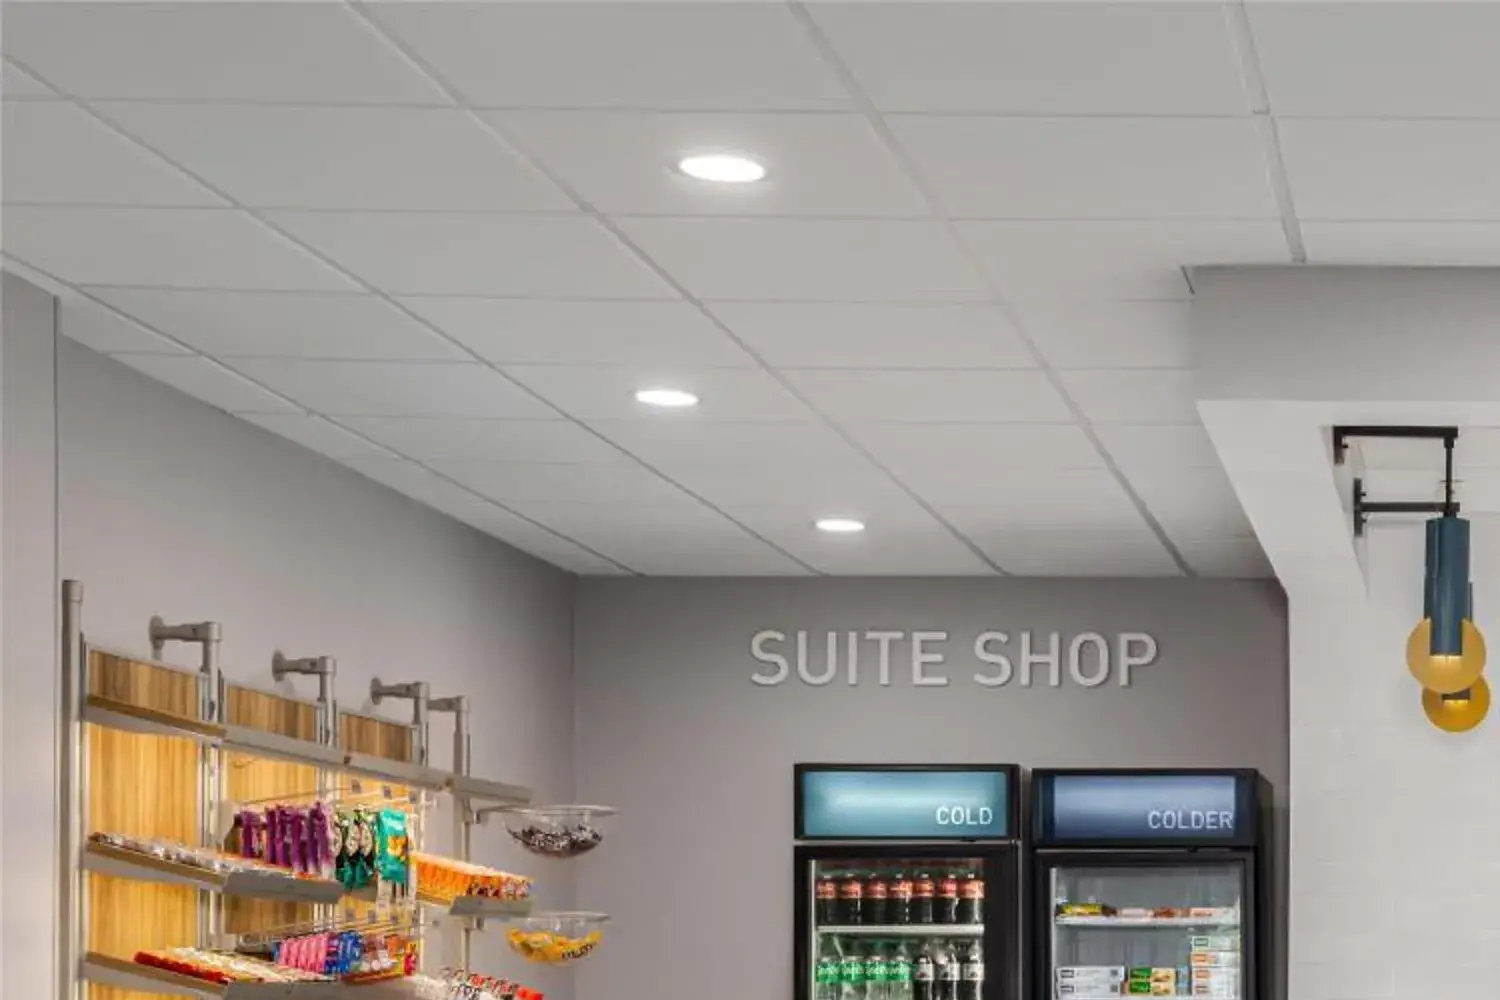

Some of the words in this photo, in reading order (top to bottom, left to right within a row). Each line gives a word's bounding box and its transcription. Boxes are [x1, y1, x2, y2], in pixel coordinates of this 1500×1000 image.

[750, 629, 949, 686] SUITE
[973, 630, 1158, 687] SHOP
[935, 806, 993, 826] COLD
[1148, 810, 1234, 829] COLDER
